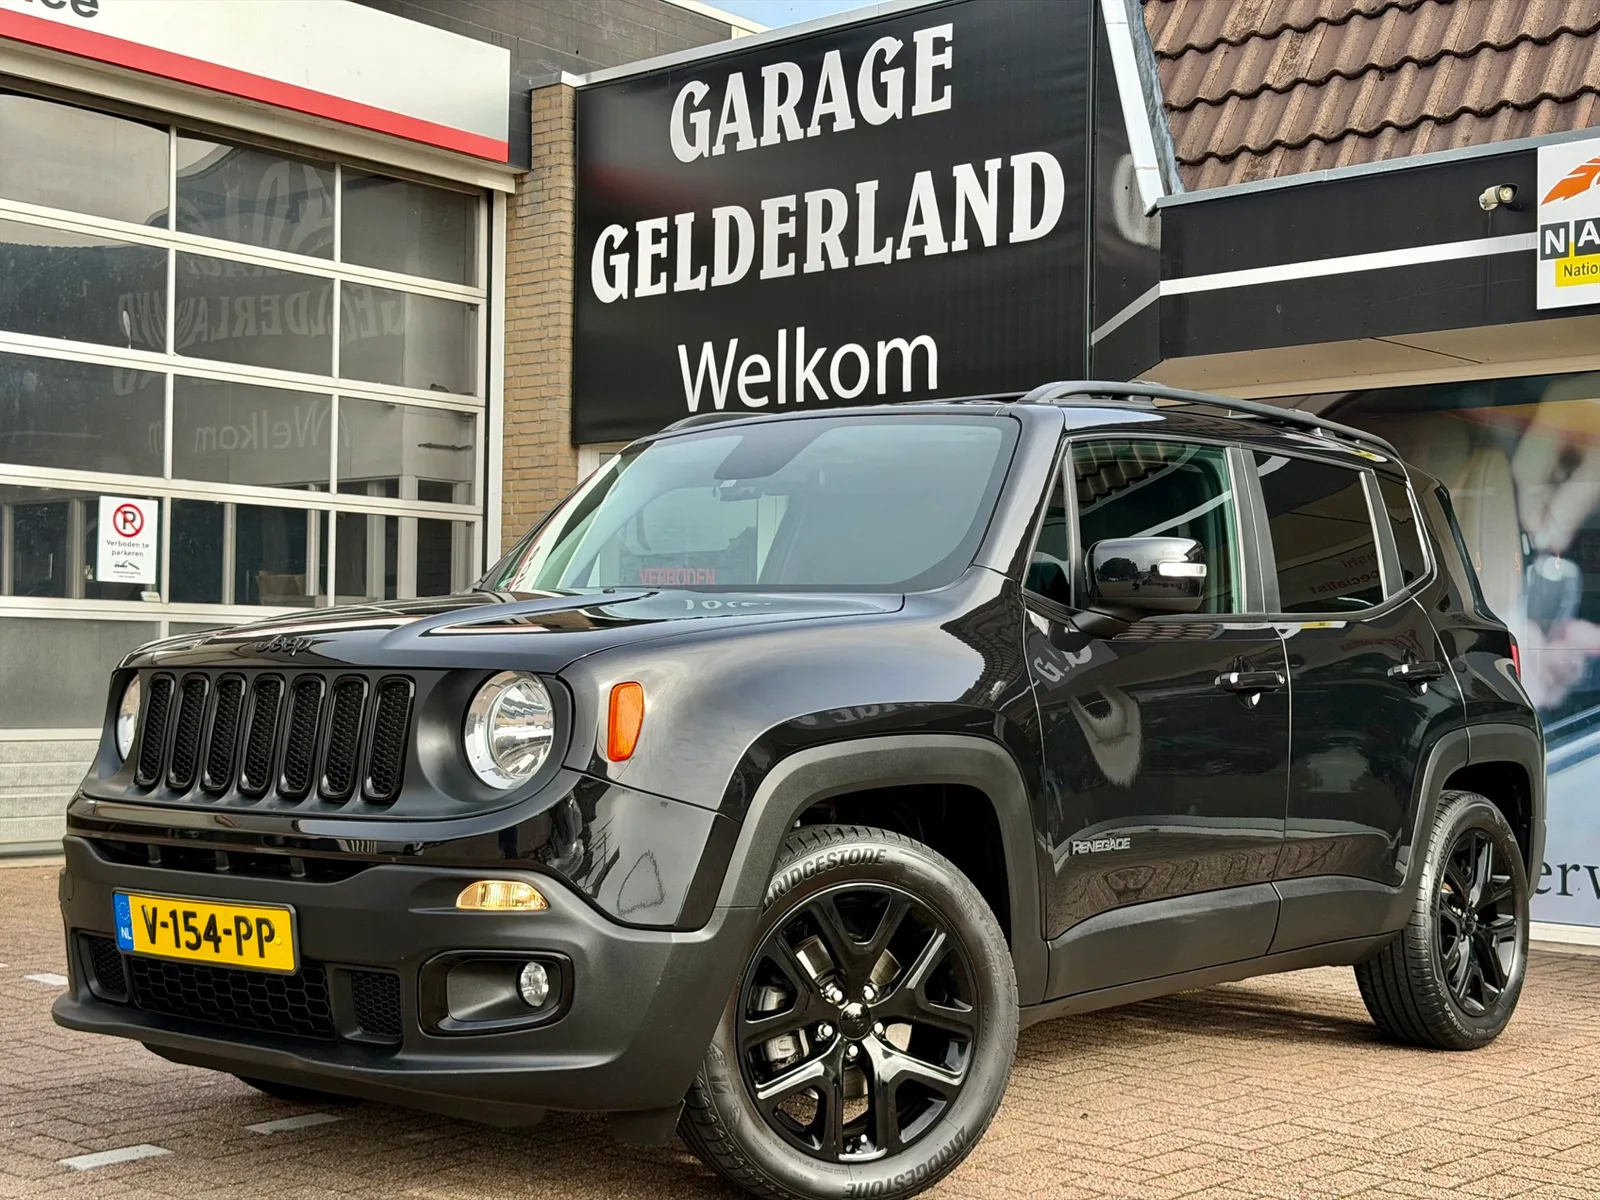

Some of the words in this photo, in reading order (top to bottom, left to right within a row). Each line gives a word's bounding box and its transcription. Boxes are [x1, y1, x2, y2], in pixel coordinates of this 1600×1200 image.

[669, 23, 954, 163] GARAGE
[591, 151, 1066, 303] GELDERLAND
[1563, 261, 1600, 278] Natio
[677, 326, 938, 412] Welkom
[106, 539, 141, 549] Verboden
[111, 549, 144, 558] parkeren
[640, 567, 716, 586] VERBODEN
[254, 634, 314, 656] Jeep
[1070, 837, 1131, 855] RENEGADE
[121, 927, 133, 940] NL
[141, 904, 276, 959] V-154-PP
[842, 1125, 971, 1199] BRIDGESTONE
